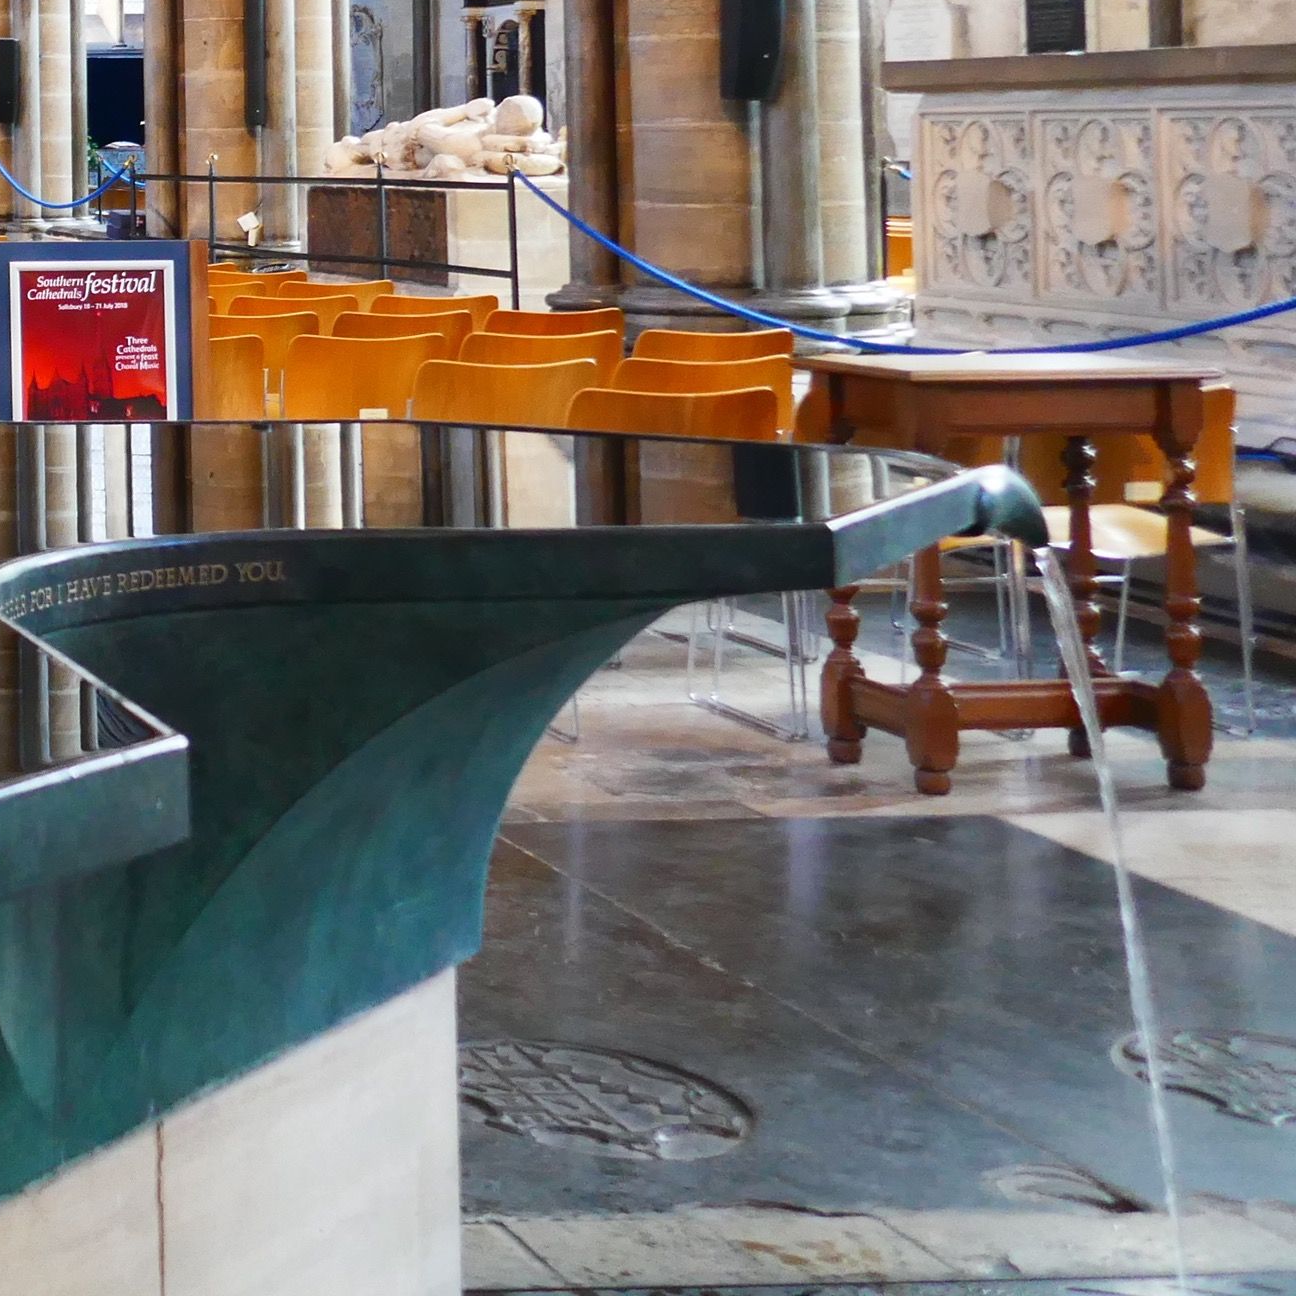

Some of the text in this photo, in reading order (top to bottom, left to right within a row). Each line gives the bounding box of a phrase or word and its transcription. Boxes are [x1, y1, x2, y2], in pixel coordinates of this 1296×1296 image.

[37, 275, 84, 288] Southern
[80, 271, 156, 302] festival
[26, 288, 82, 301] Cathedrals
[125, 336, 148, 346] Three
[116, 345, 158, 354] Cathedrals
[140, 354, 159, 362] feast
[115, 361, 160, 371] Choral Music
[30, 586, 54, 612] FOR
[57, 583, 62, 605] I
[66, 574, 112, 604] HAVE
[116, 563, 229, 594] REDEEMED
